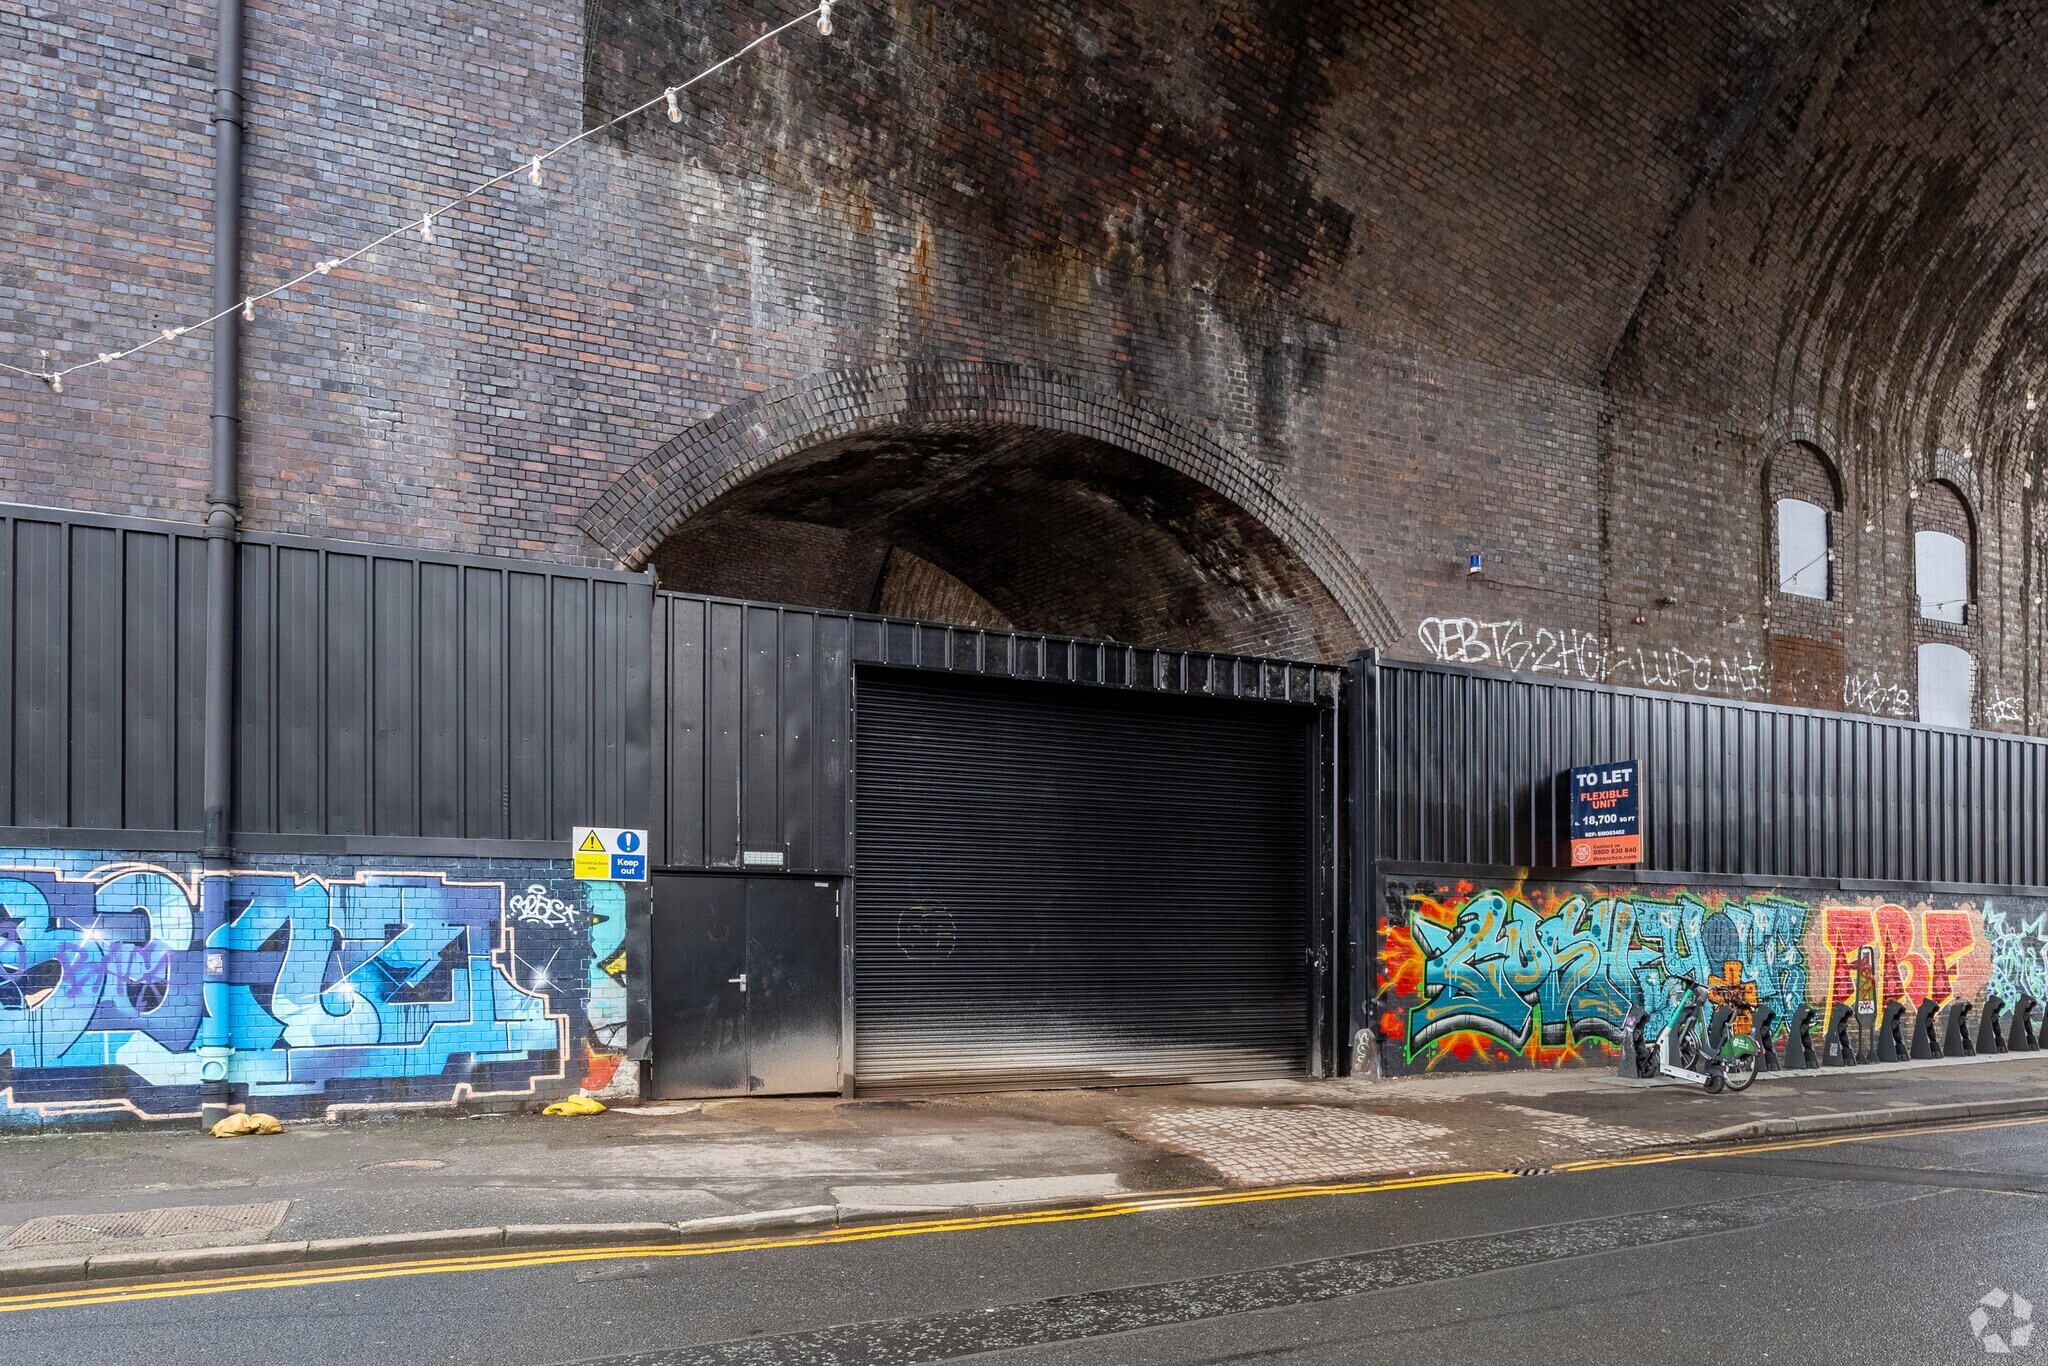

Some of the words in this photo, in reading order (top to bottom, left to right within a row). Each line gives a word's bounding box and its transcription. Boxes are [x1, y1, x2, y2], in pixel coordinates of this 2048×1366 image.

[1576, 772, 1598, 787] TO
[1602, 768, 1632, 784] LET
[1580, 788, 1629, 801] FLEXIBLE
[1592, 799, 1617, 809] UNIT
[1582, 814, 1617, 826] 18,700
[617, 857, 639, 868] Keep
[621, 867, 635, 875] out
